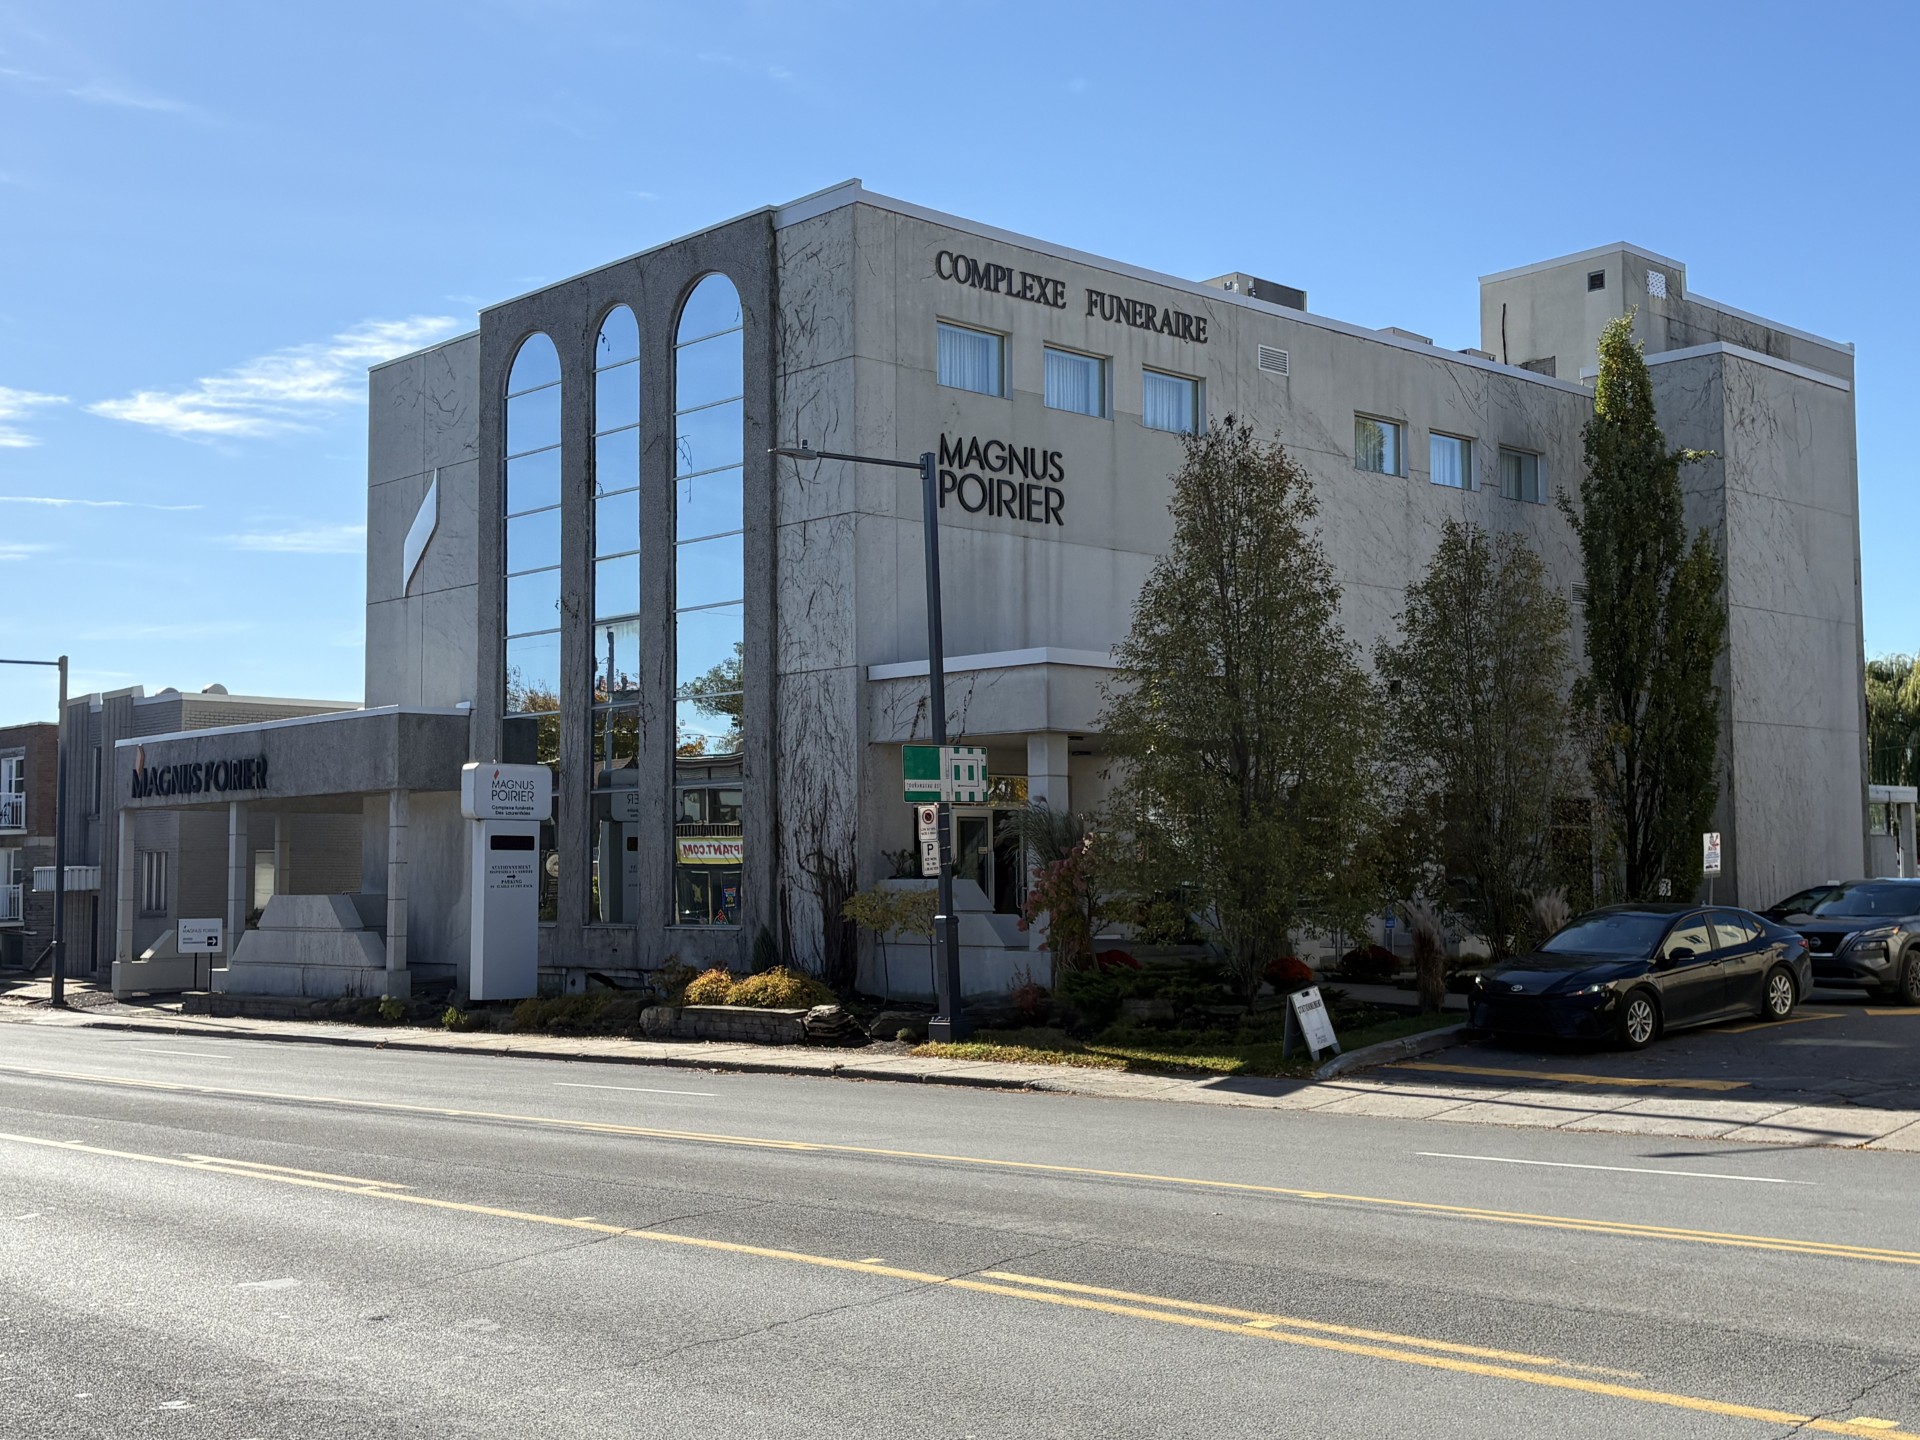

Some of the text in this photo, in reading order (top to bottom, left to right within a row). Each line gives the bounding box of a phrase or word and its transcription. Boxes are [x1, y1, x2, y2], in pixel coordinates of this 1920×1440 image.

[935, 250, 1208, 343] COMPLEXE FUNERAIRE
[939, 433, 1065, 482] MAGNUS
[939, 469, 1065, 526] POIRIER
[131, 763, 203, 798] MAGNUS
[491, 780, 535, 790] MAGNUS
[491, 789, 535, 802] POIRIER
[927, 843, 934, 856] P
